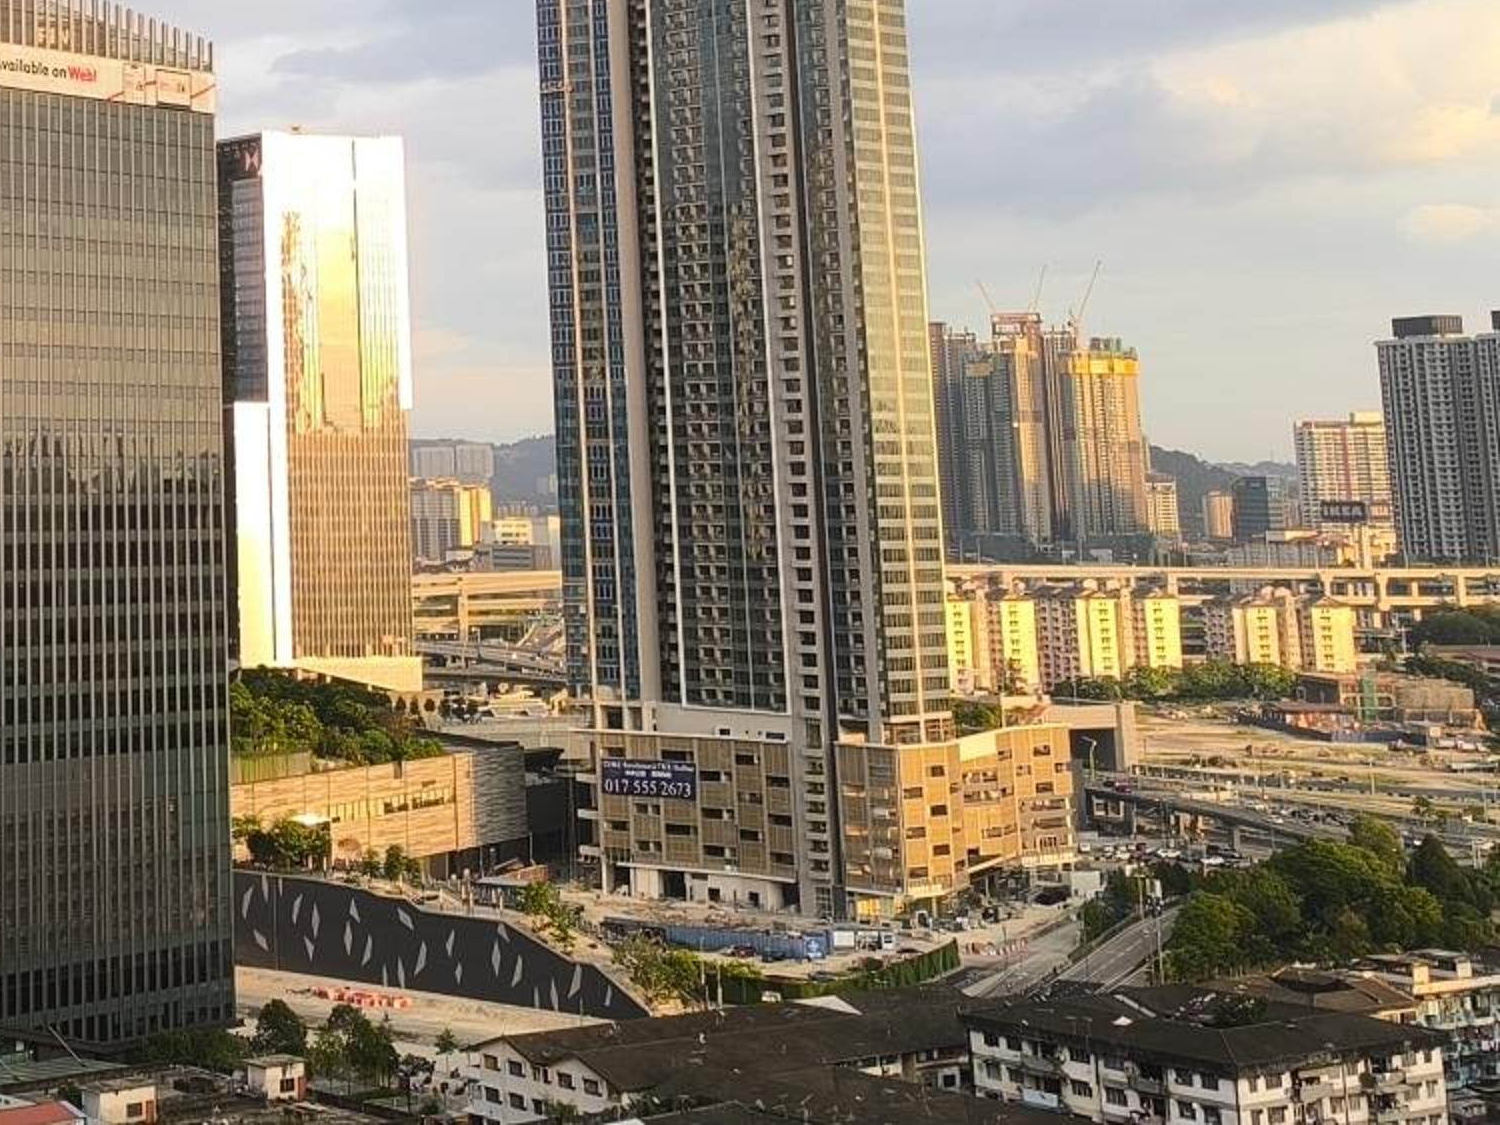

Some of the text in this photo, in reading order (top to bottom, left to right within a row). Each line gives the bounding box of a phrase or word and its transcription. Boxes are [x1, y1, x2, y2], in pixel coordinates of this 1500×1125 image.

[52, 67, 67, 78] on
[68, 65, 97, 82] Web!
[604, 778, 691, 798] 017 555 2673
